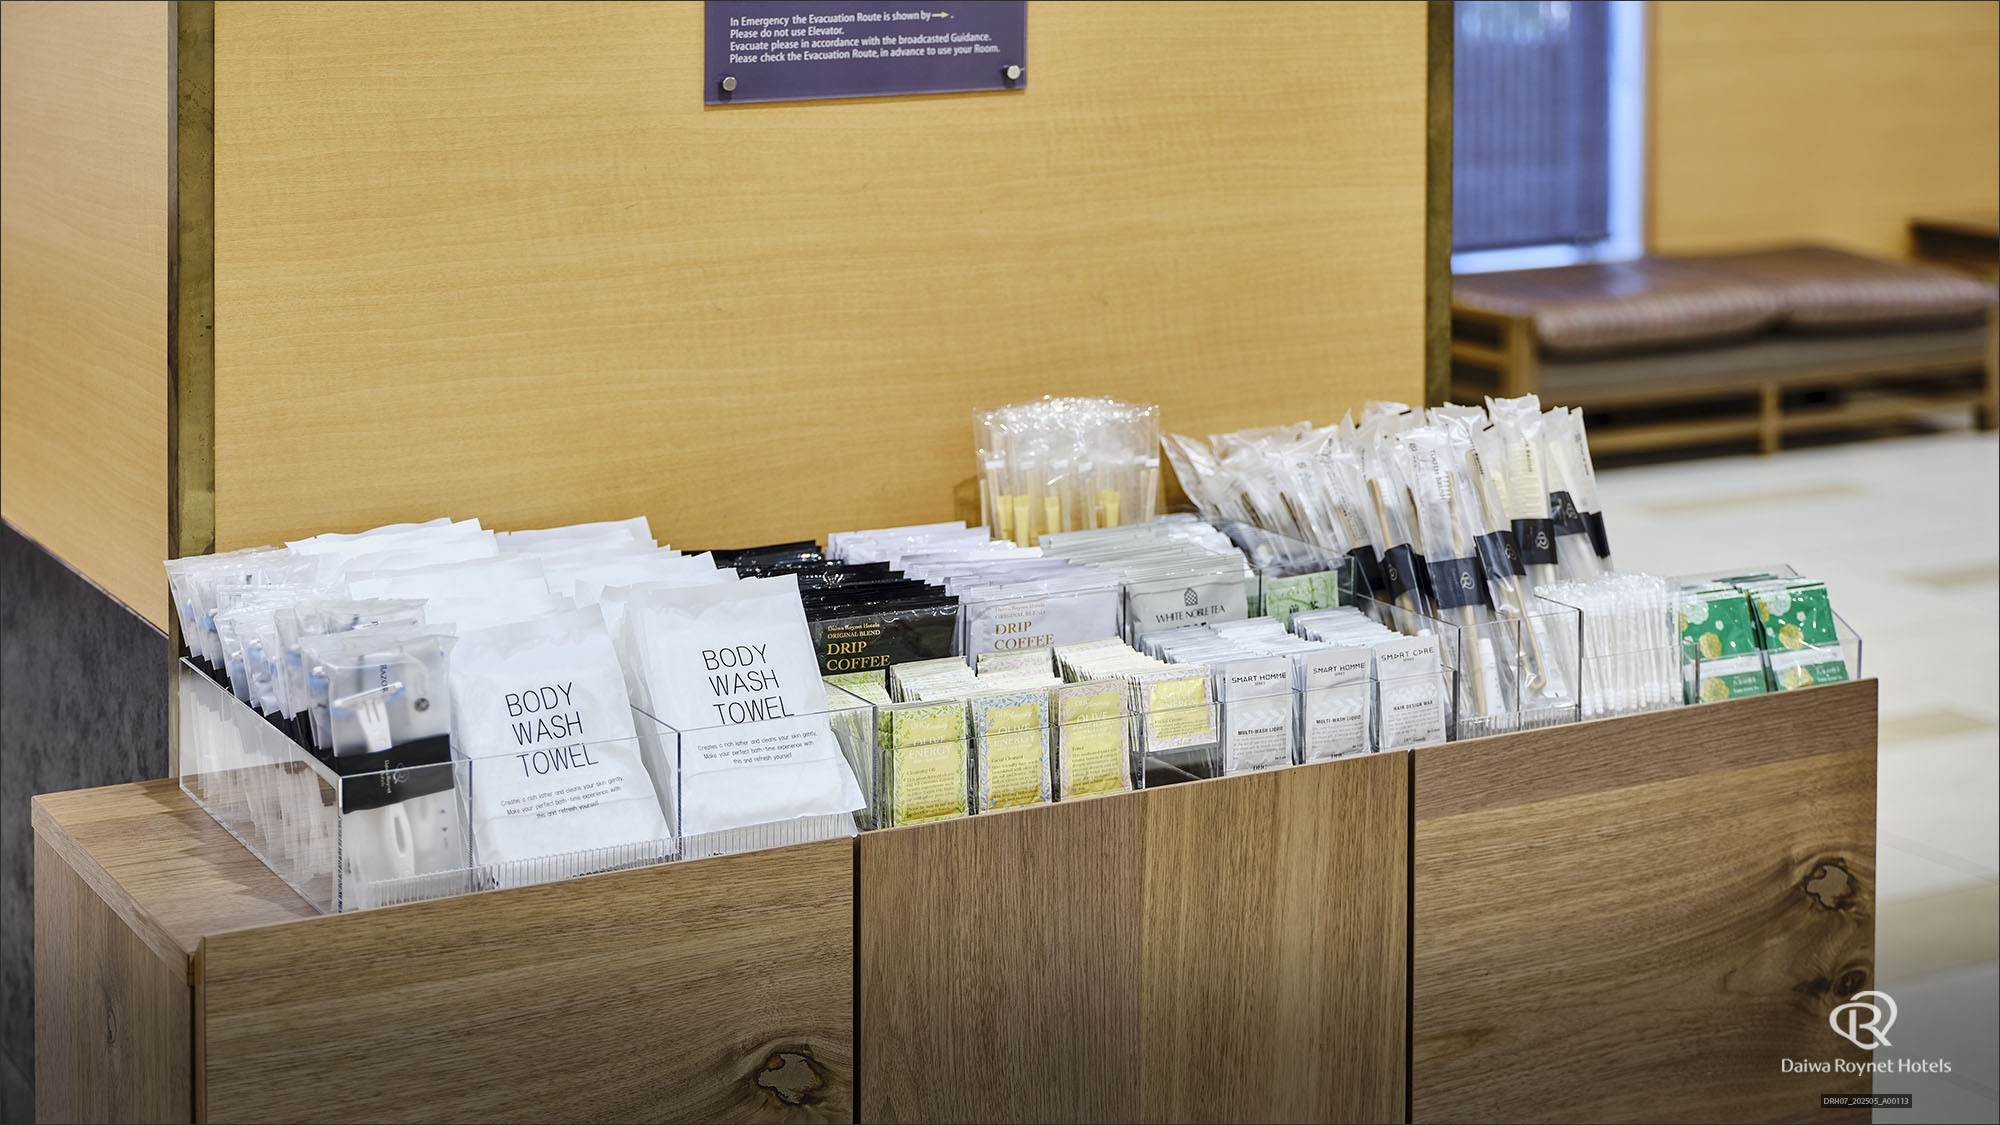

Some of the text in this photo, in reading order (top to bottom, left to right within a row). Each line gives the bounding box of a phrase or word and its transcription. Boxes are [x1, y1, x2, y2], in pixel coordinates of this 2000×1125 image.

[730, 10, 932, 28] In Emergency the Evacuation Route is shown by
[730, 26, 845, 39] Please do not use Elevator.
[730, 32, 992, 51] Evacuate please in accordance with the broadcasted Guidance.
[729, 43, 1000, 64] Please check the Evacuation Route, in advance to use your Room.
[1155, 605, 1226, 624] WHITE NOBLE TEA
[827, 629, 881, 639] ORIGINAL BLEND
[995, 621, 1032, 635] DRIP
[826, 641, 868, 656] DRIP
[994, 633, 1054, 650] COFFEE
[702, 643, 767, 671] BODY
[826, 654, 891, 671] COFFEE
[1313, 662, 1366, 674] SMART HOMME
[708, 669, 780, 697] WASH
[1231, 672, 1287, 683] SMART HOMME
[505, 681, 572, 717] BODY
[712, 695, 795, 725] TOWEL
[1076, 712, 1107, 722] OLIVE
[512, 711, 583, 746] WASH
[997, 723, 1031, 734] OLIVE
[698, 743, 718, 752] Creates
[761, 736, 778, 744] cleans
[778, 734, 789, 742] your
[719, 751, 730, 759] your
[731, 748, 750, 757] perfect
[776, 742, 803, 751] experience
[516, 742, 599, 777] TOWEL
[753, 754, 773, 762] refresh
[909, 744, 952, 760] ENERGY
[500, 798, 521, 807] Creates
[538, 791, 553, 800] lather
[565, 785, 582, 794] cleans
[583, 783, 594, 791] your
[506, 808, 521, 816] Make
[522, 806, 533, 814] your
[535, 801, 554, 810] perfect
[582, 789, 609, 800] experience
[610, 785, 622, 793] with
[558, 805, 578, 814] refresh
